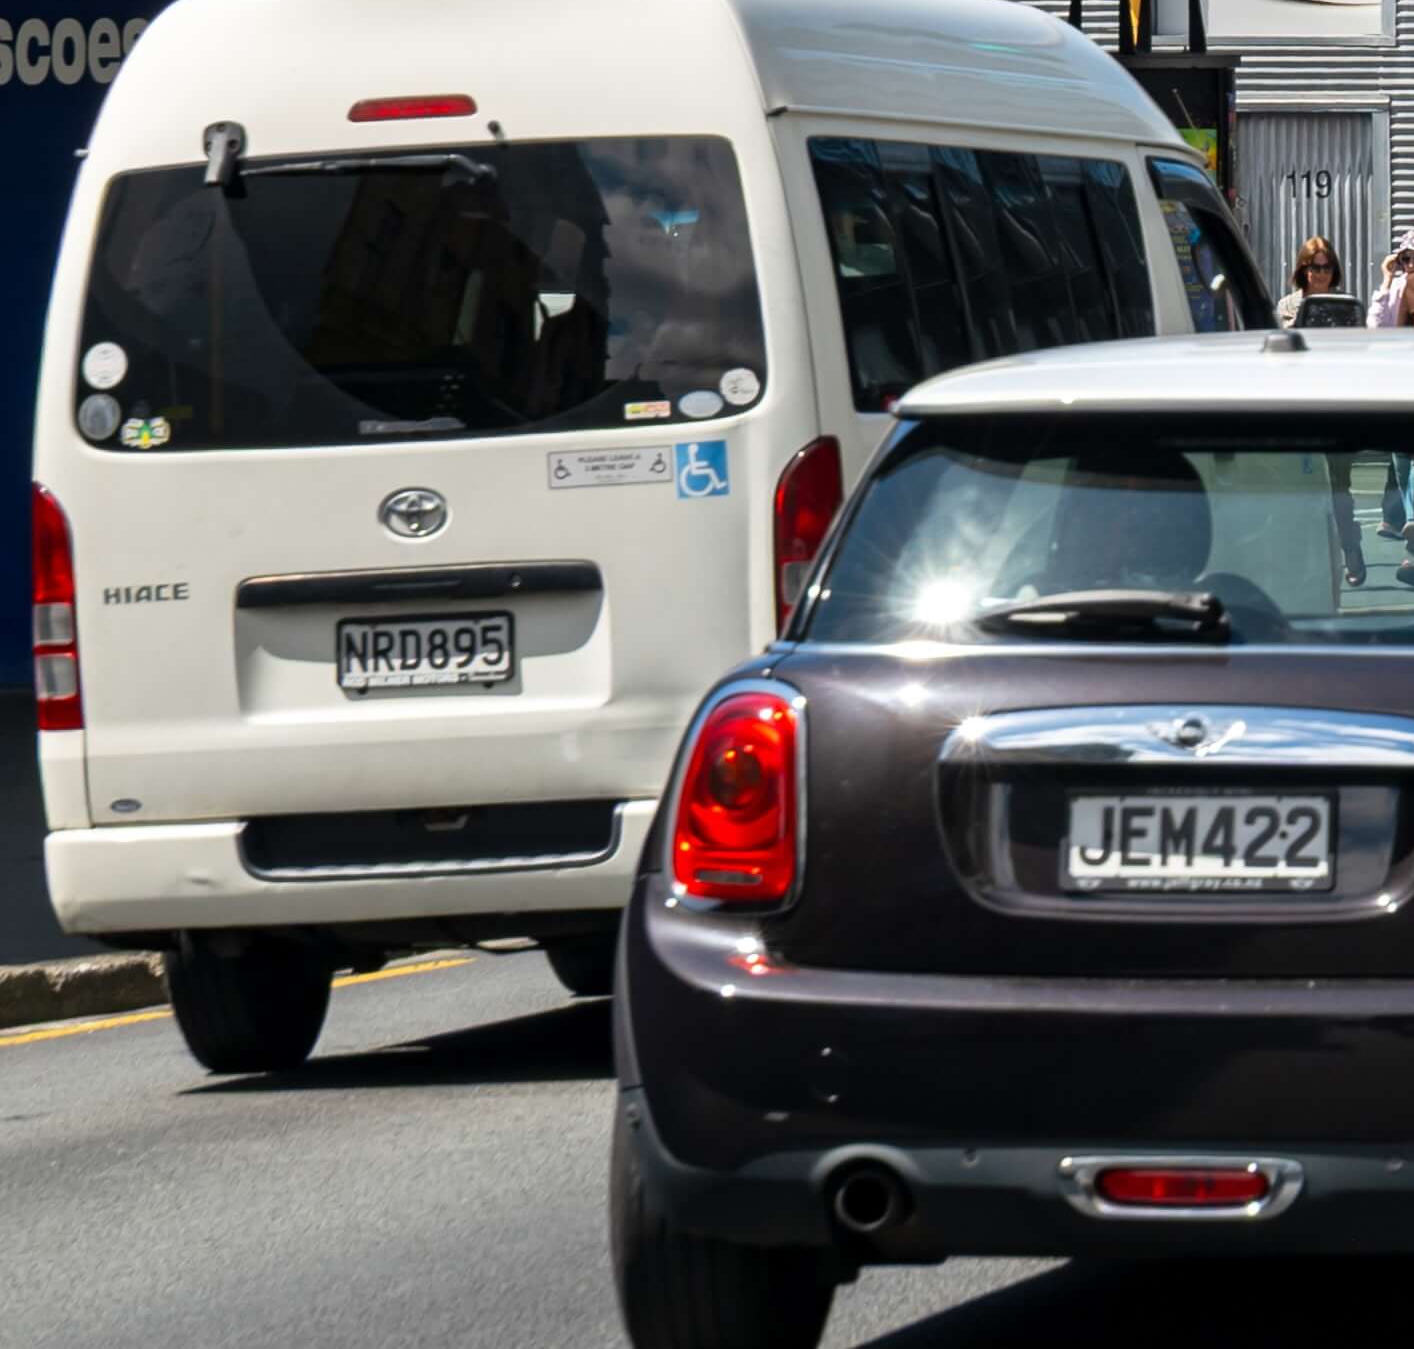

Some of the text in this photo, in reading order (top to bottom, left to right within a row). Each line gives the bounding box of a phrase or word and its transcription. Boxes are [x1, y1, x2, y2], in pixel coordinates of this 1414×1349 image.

[1287, 170, 1331, 199] 119
[103, 582, 189, 605] HIACE
[345, 625, 503, 672] NRD895
[1080, 806, 1321, 867] JEM422
